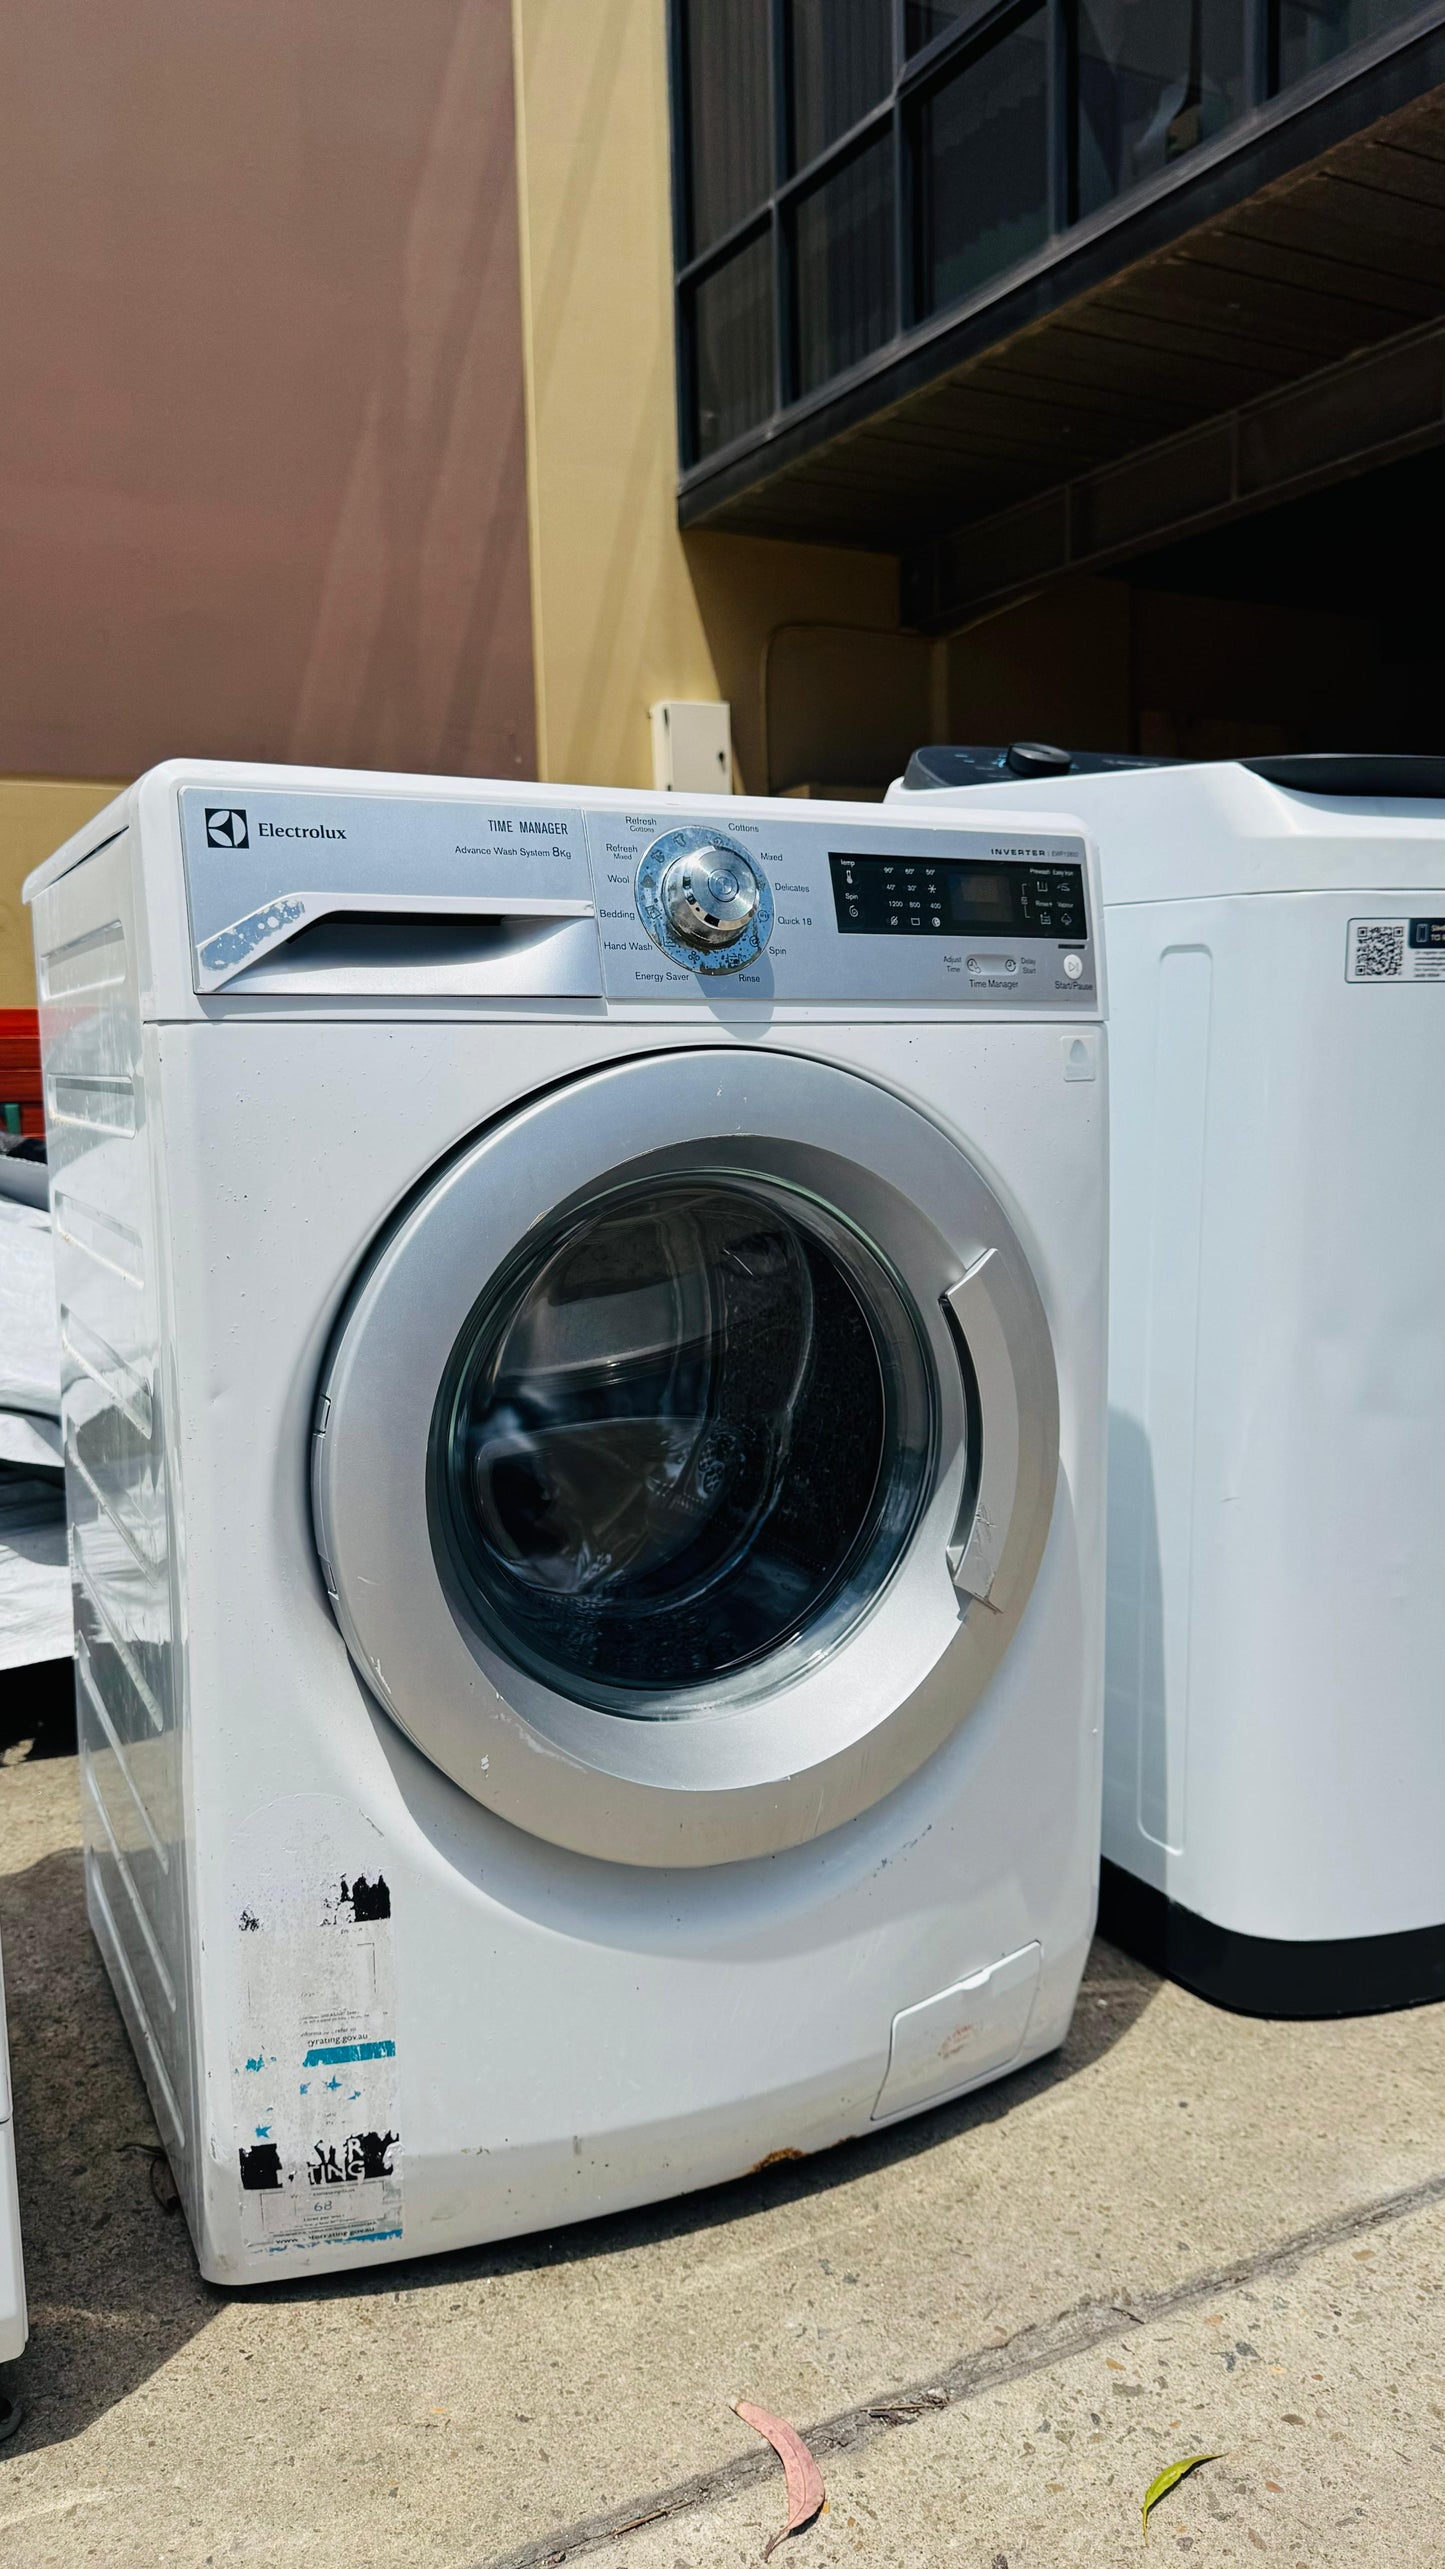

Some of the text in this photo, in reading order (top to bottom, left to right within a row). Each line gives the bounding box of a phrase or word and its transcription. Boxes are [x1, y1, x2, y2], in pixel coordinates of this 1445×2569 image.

[625, 816, 657, 826] Refresh
[258, 822, 347, 840] Electrolux
[488, 819, 568, 835] TIME MANAGER
[728, 822, 760, 833] Cottons
[454, 845, 491, 857] Advance
[493, 846, 518, 857] Wash
[519, 847, 550, 860] System
[606, 843, 638, 853] Refresh
[991, 848, 1045, 857] INVERTER
[760, 852, 783, 862] Mixed
[607, 875, 630, 884] Wool
[774, 882, 810, 893] Delicates
[845, 892, 859, 901] Spin
[888, 900, 904, 908] 1200
[930, 902, 942, 910] 400
[599, 909, 636, 921] Bedding
[777, 916, 812, 926] Quick 18
[603, 941, 653, 951] Hand Wash
[768, 946, 787, 956] Spin
[943, 955, 962, 964] Adjust
[947, 965, 961, 973] Time
[635, 971, 689, 983] Energy Saver
[738, 973, 761, 983] Rinse
[969, 979, 1019, 990] Time Manager
[1054, 980, 1094, 991] Start/Pause
[313, 2200, 333, 2212] 68
